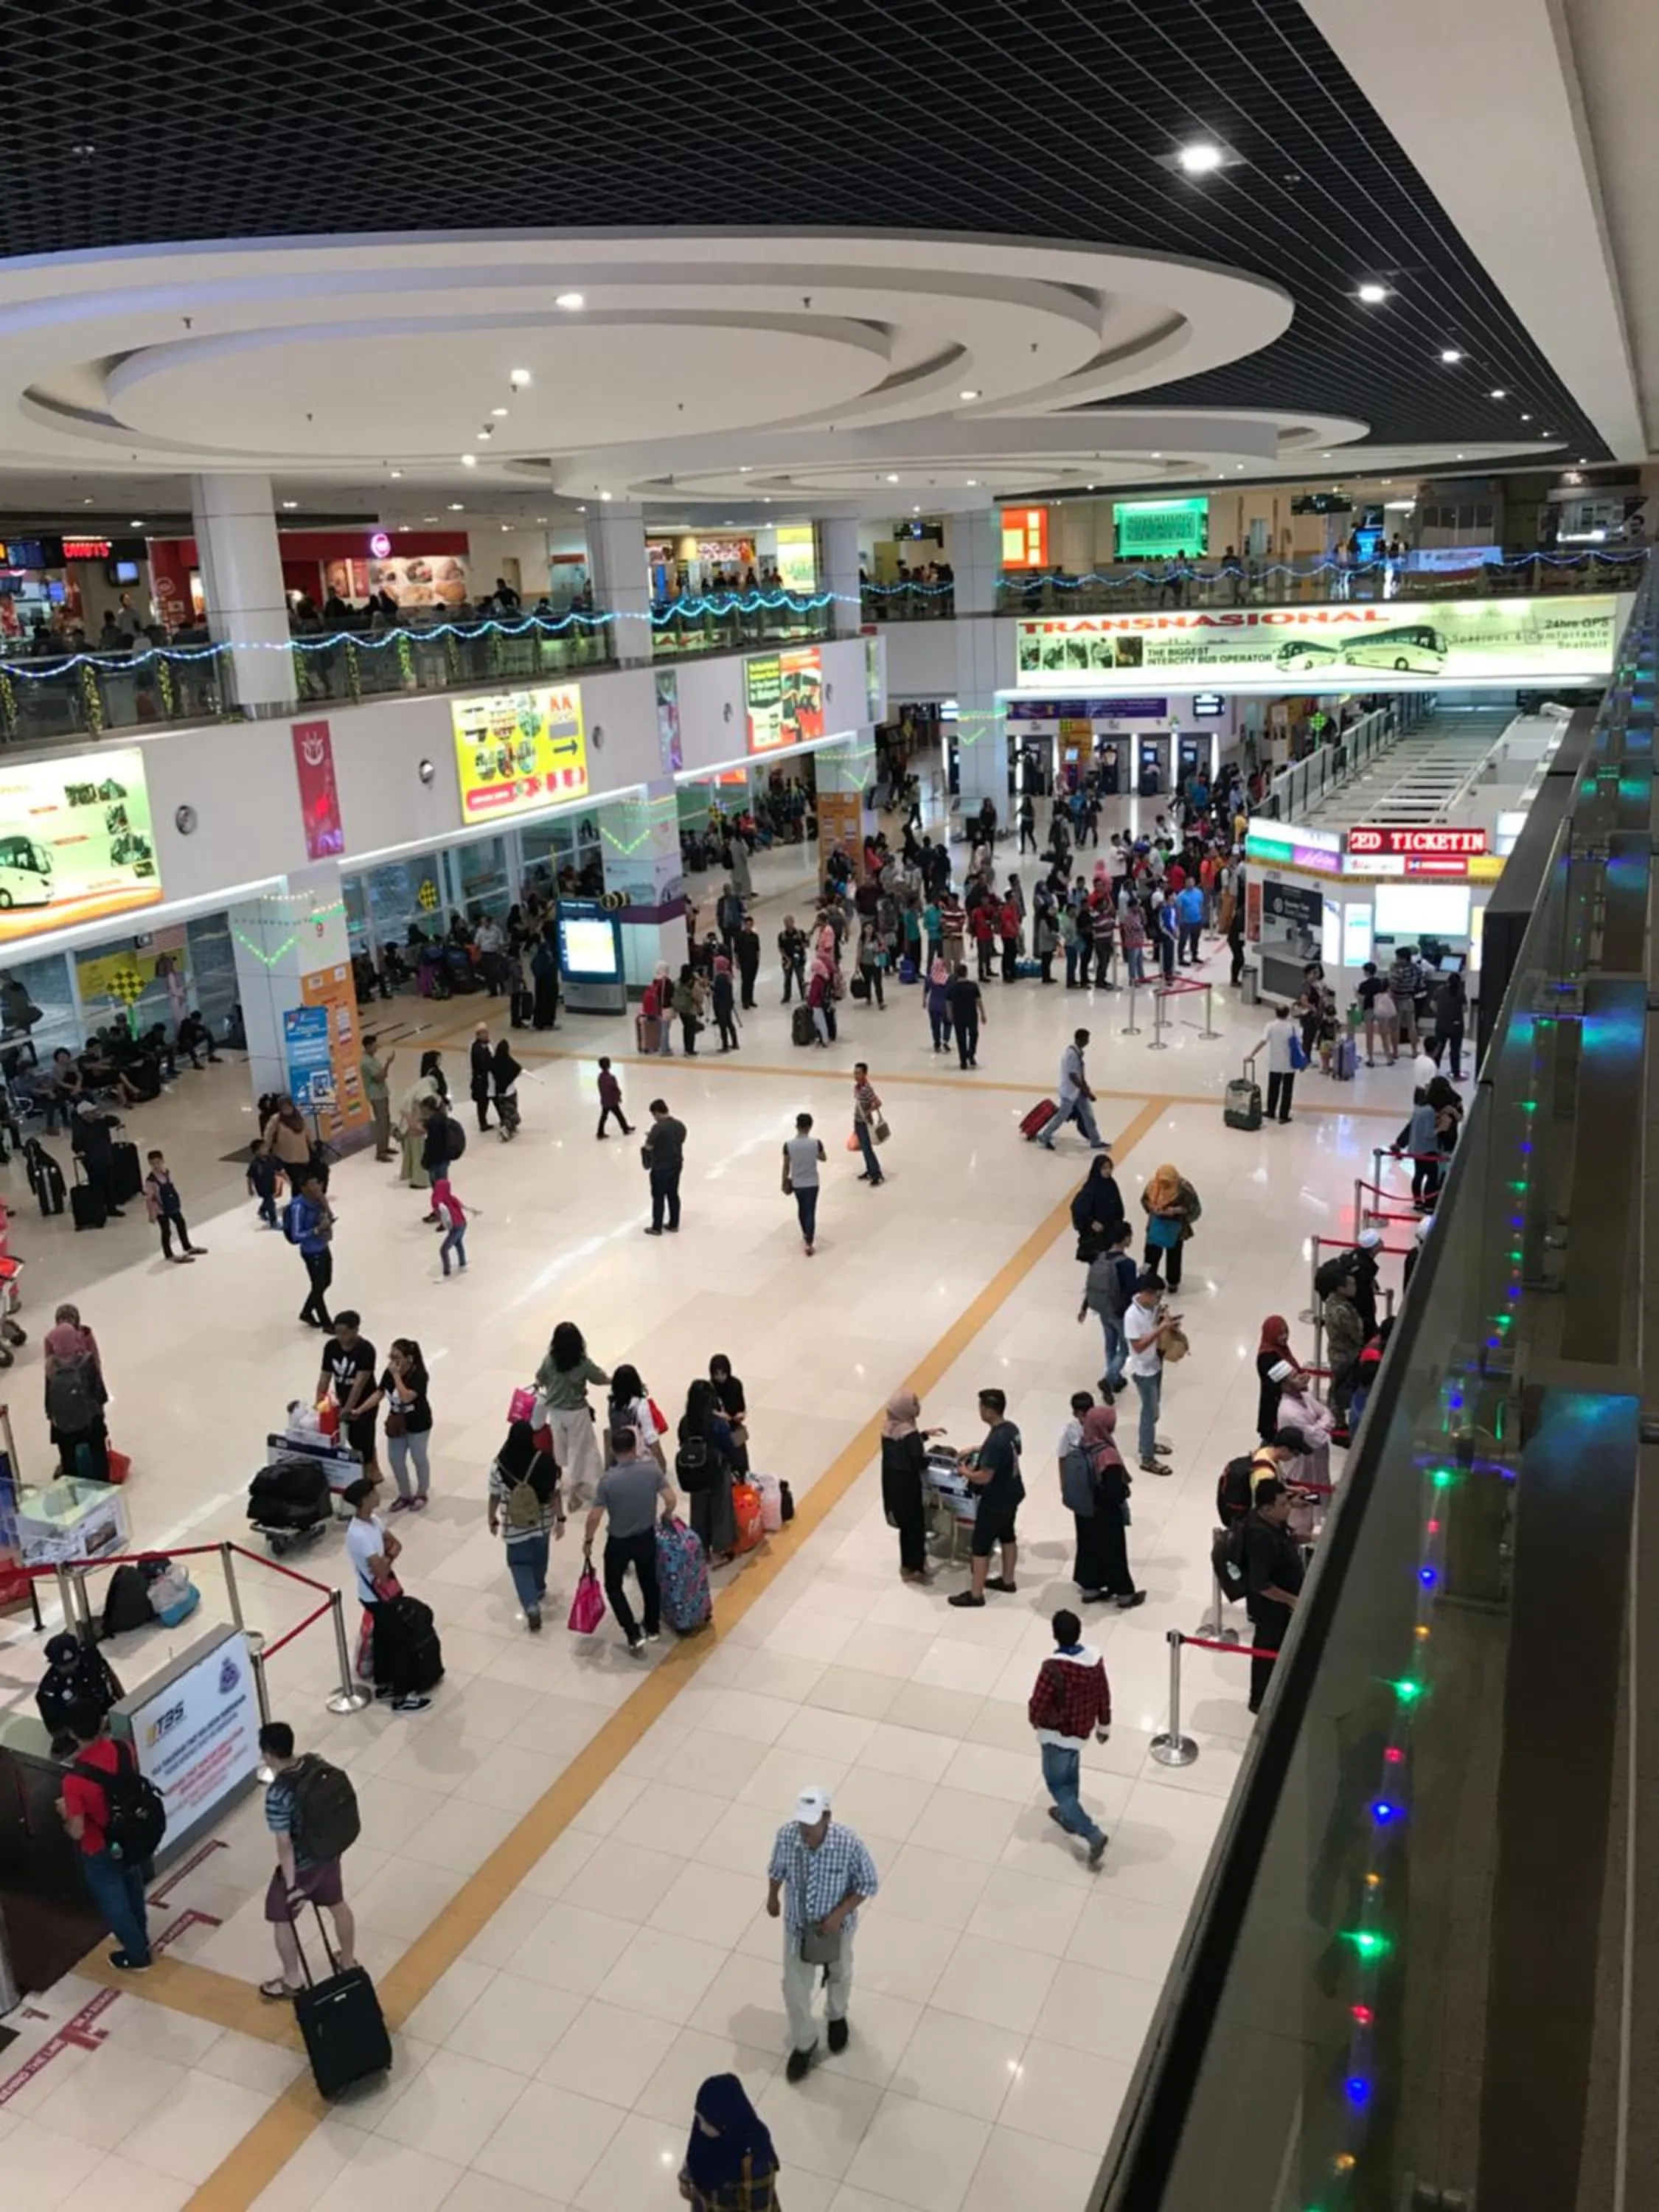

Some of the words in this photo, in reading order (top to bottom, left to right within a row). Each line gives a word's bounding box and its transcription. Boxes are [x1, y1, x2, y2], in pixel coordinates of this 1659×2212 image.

[1019, 609, 1389, 634] TRANSNASIONAL
[1147, 648, 1164, 656] THE
[1167, 647, 1209, 656] BIGGEST
[1147, 657, 1194, 666] INTERCITY
[1197, 655, 1217, 664] BUS
[1220, 653, 1272, 663] OPERATOR
[1391, 832, 1484, 850] TICKETIN
